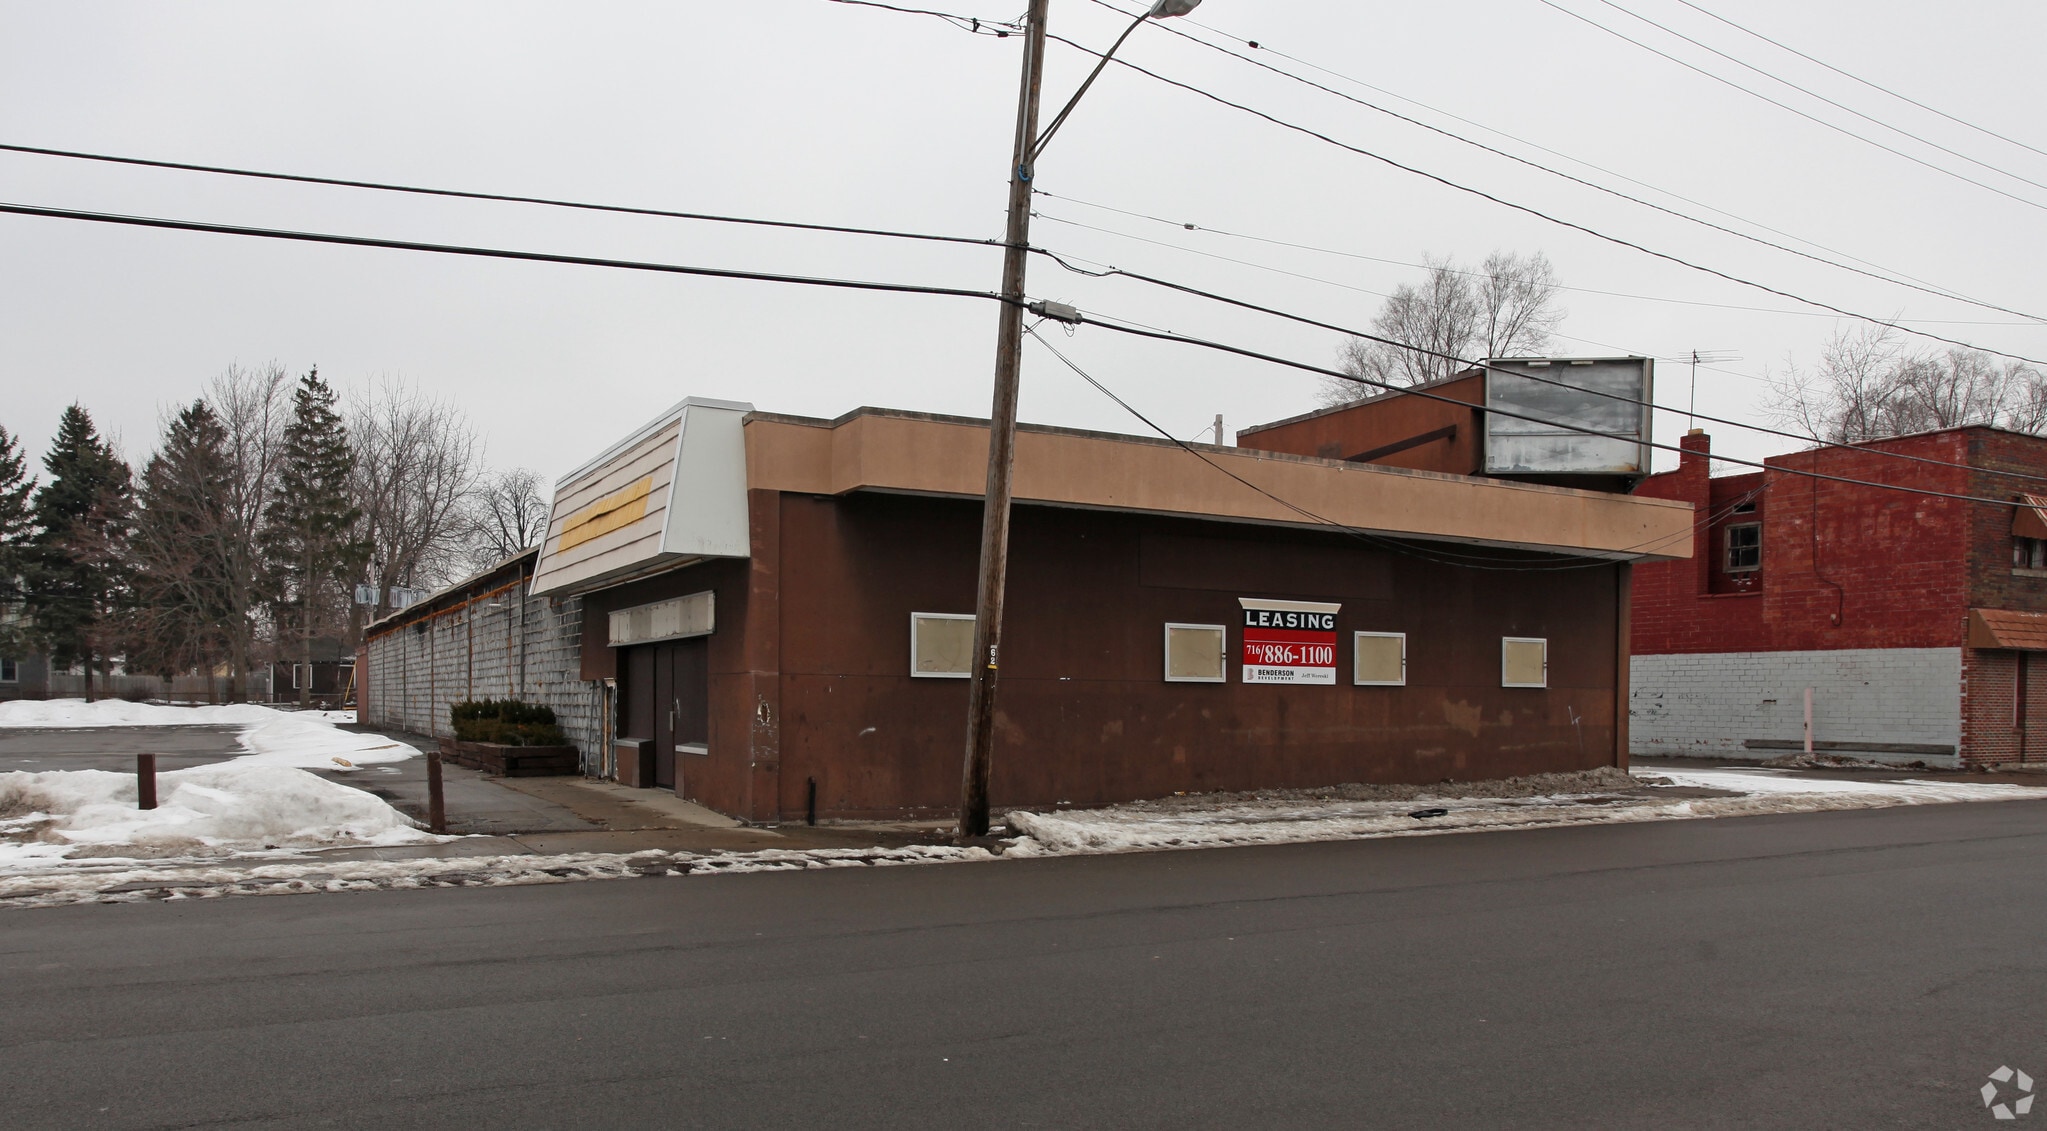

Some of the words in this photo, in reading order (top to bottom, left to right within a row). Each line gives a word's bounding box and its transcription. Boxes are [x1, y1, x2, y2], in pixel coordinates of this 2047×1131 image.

[1246, 611, 1334, 629] LEASING
[1246, 644, 1333, 665] 716/886-1100
[1258, 669, 1294, 677] BENDERSON
